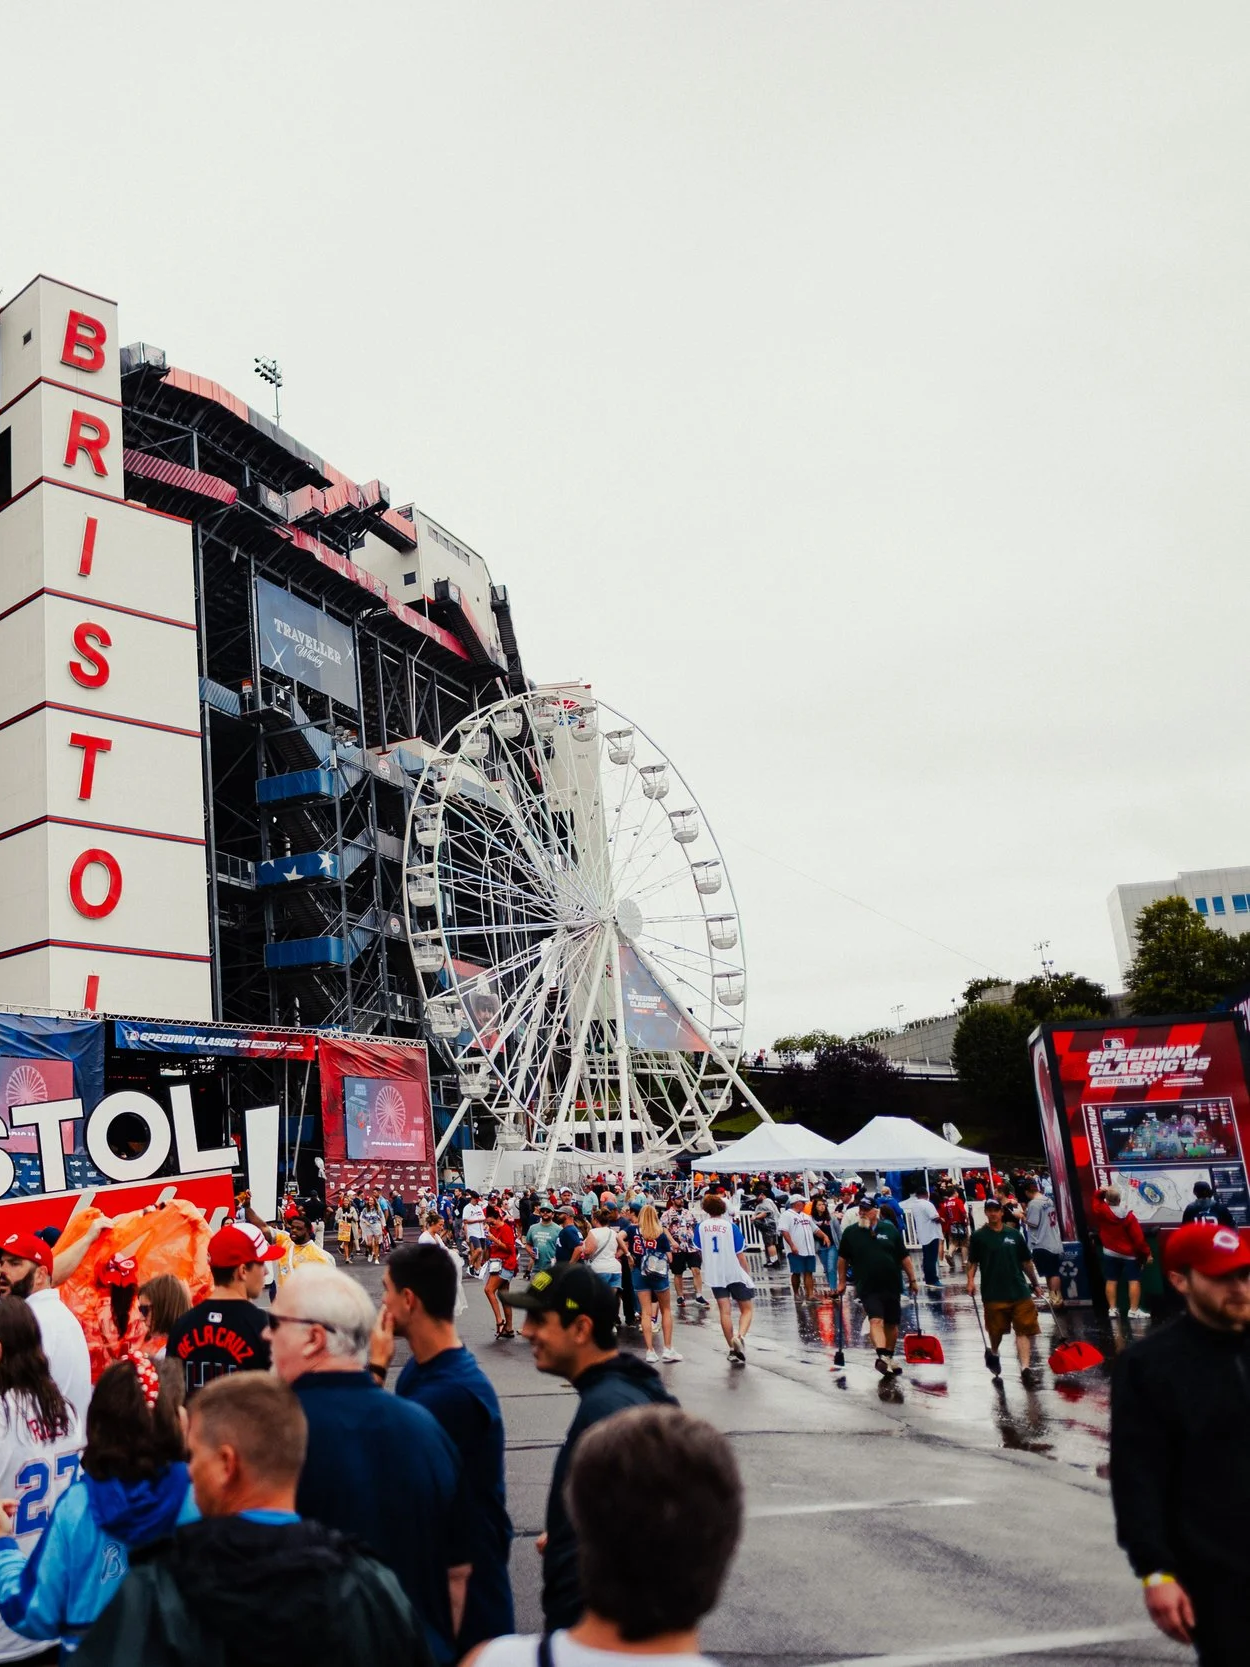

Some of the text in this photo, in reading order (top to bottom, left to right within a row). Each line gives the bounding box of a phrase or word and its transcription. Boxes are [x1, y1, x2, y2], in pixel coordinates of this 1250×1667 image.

[273, 617, 342, 666] TRAVELLER
[139, 1032, 196, 1046] SPEEDWAY
[195, 1036, 237, 1048] CLASSIC
[1086, 1045, 1202, 1064] SPEEDWAY
[1088, 1058, 1180, 1077] CLASSIC
[1086, 1105, 1105, 1165] FAN ZONE MAP
[703, 1224, 727, 1234] ALBIES
[711, 1236, 719, 1253] 1
[215, 1326, 255, 1364] CRUZ
[13, 1448, 85, 1539] 27
